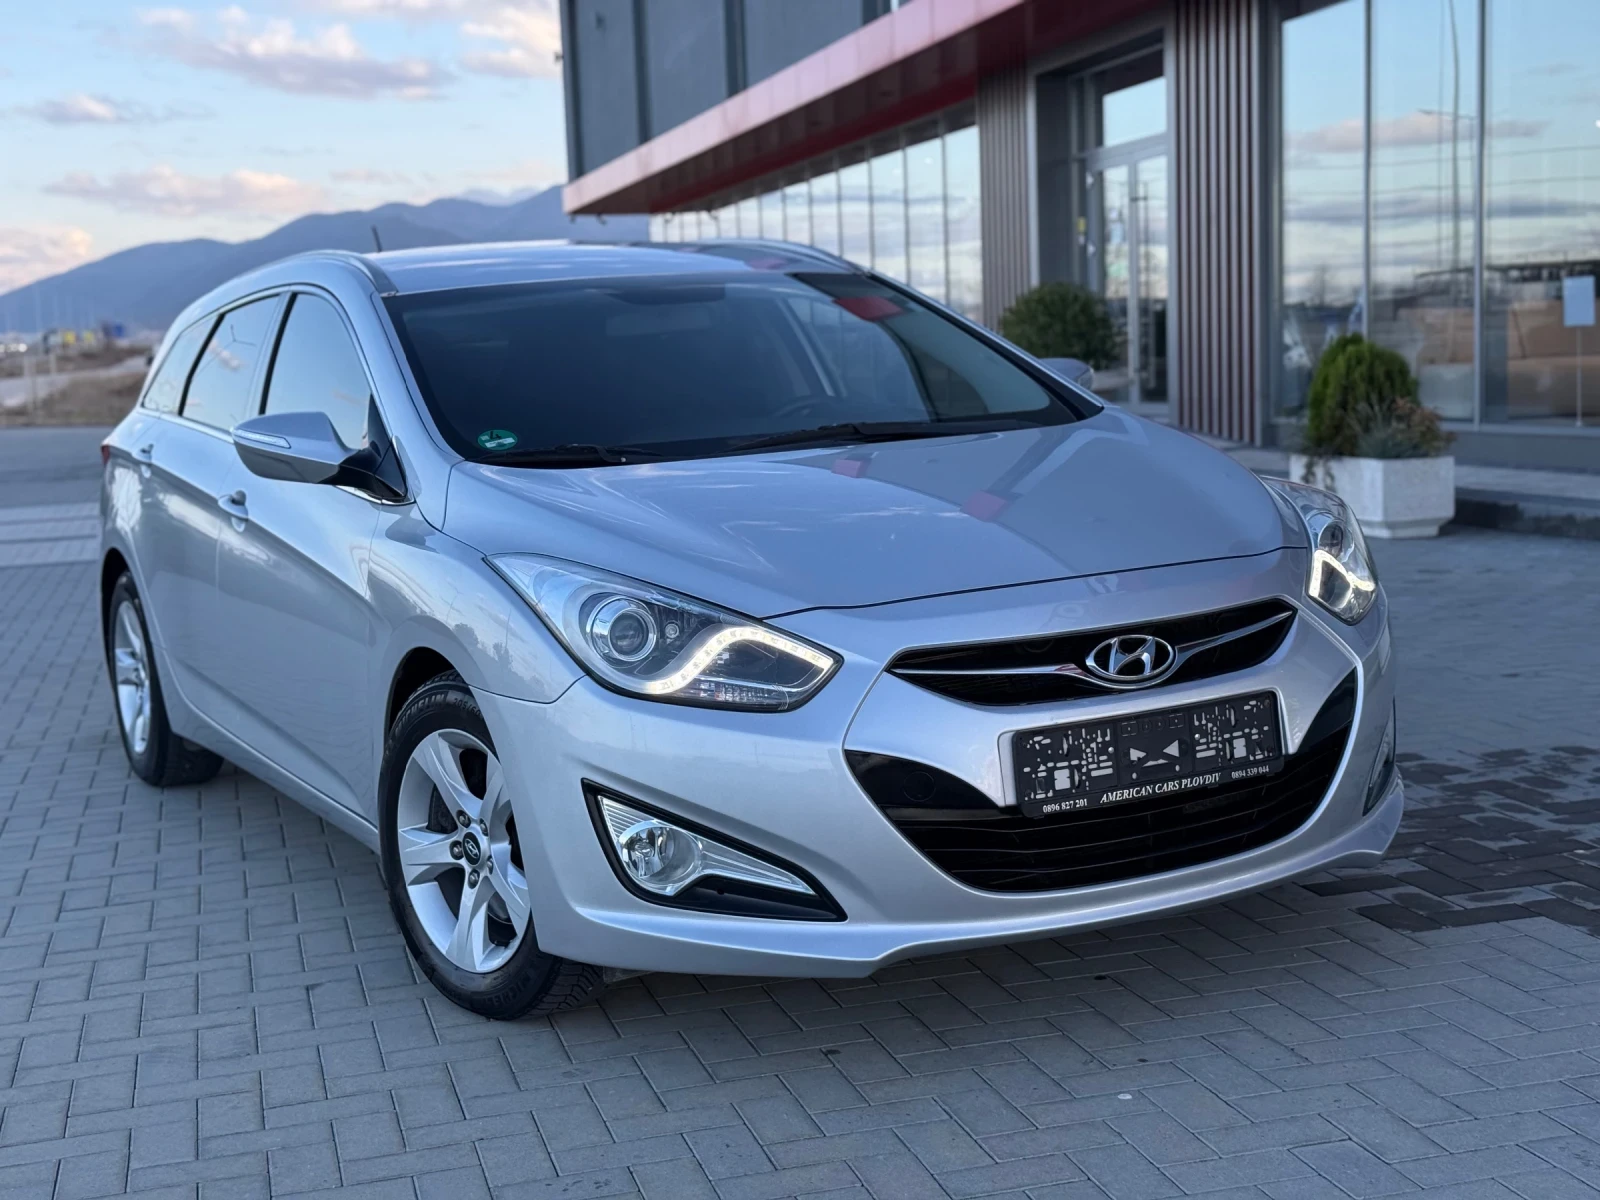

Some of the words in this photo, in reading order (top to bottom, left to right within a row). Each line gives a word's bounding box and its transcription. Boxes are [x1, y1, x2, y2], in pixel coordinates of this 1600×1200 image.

[1231, 769, 1246, 779] 0894
[1246, 767, 1258, 777] 339
[1258, 764, 1270, 774] 044
[1100, 784, 1154, 804] AMERICAN
[1155, 780, 1180, 793] CARS
[1181, 772, 1221, 789] PLOVDIV
[1042, 803, 1060, 813] 0896
[1061, 800, 1074, 810] 827
[1075, 798, 1088, 808] 201
